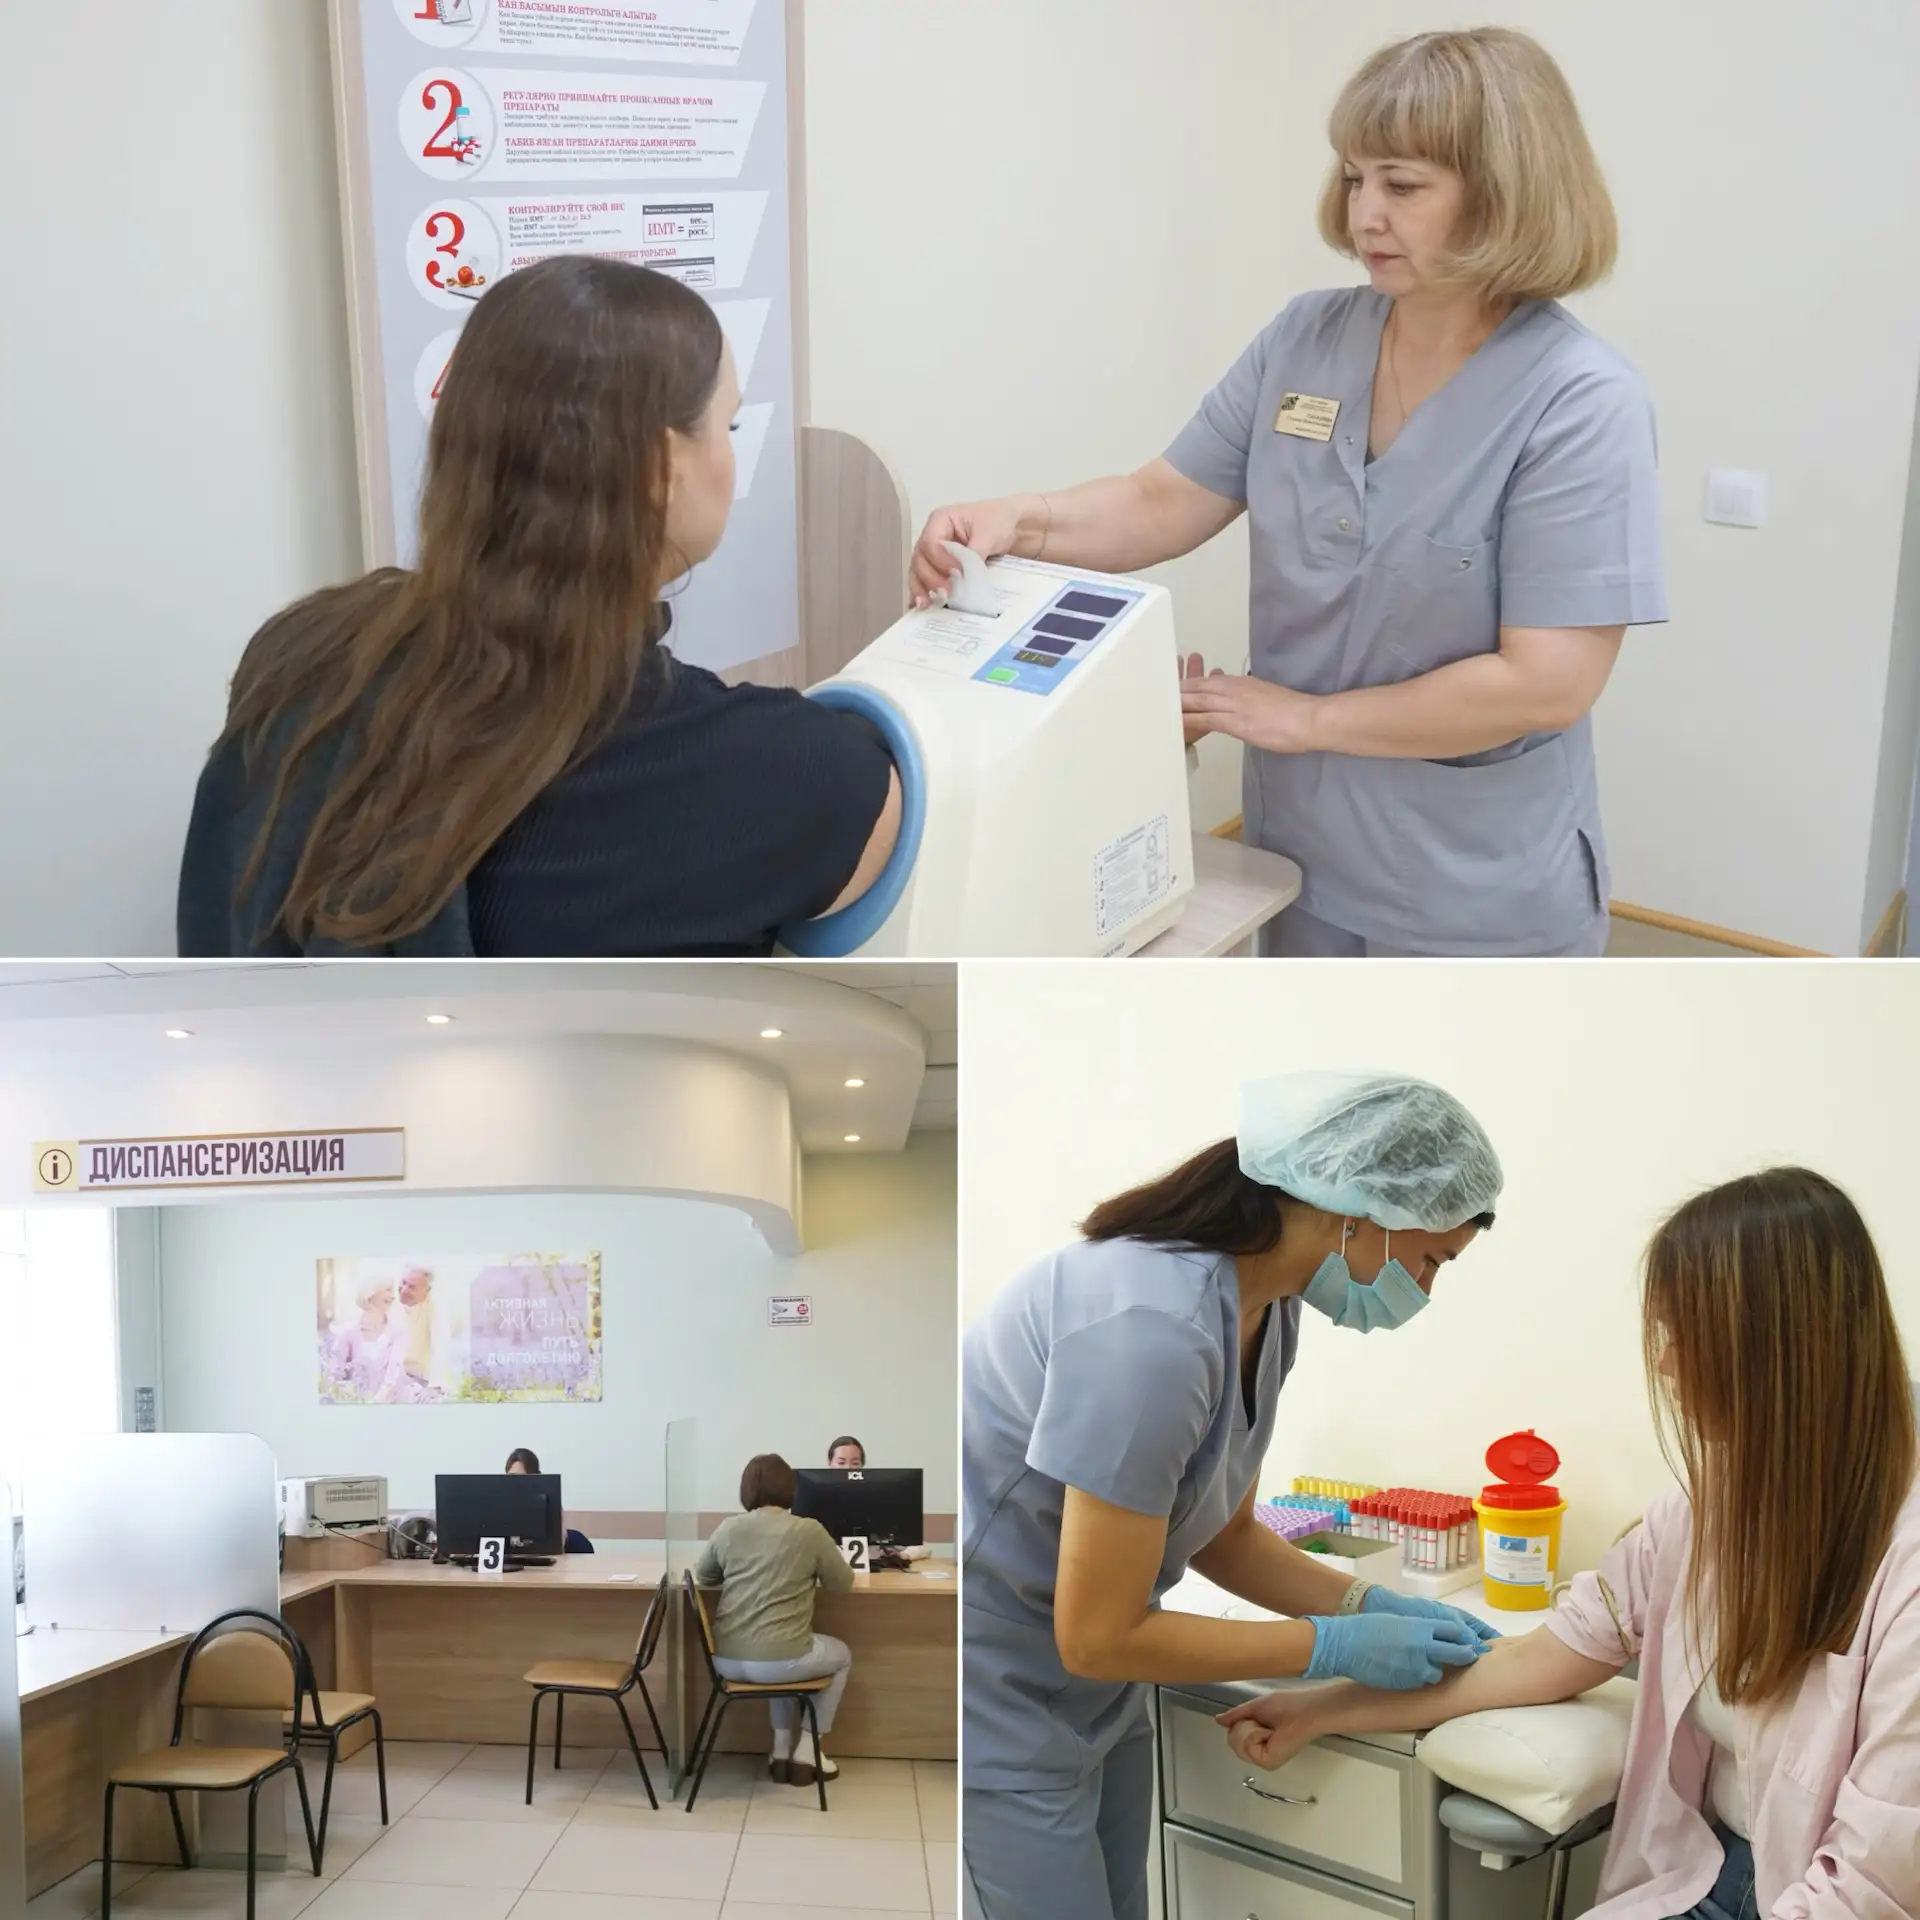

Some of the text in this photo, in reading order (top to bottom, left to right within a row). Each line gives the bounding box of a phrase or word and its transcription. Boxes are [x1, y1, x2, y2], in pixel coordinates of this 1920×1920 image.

[503, 91, 713, 106] РЕГУЛЯРНО ПРИНИМАЙТЕ ПРОПИСАННЫЕ ВРАЧОМ
[503, 102, 559, 111] ПРЕПАРАТЫ
[422, 79, 463, 157] 2
[508, 202, 625, 215] КОНТРОЛИРУЙТЕ СВОЙ ВЕС
[648, 222, 675, 236] ИМТ
[426, 211, 465, 288] 3
[89, 1138, 345, 1183] ДИСПАНСЕРИЗАЦИЯ
[484, 1298, 547, 1309] АКТИВНАЯ
[499, 1311, 579, 1330] ЖИЗНЬ
[543, 1336, 579, 1348] ПУТЬ
[486, 1352, 580, 1366] ДОЛГОЛЕТИЮ
[483, 1541, 500, 1569] 3
[848, 1540, 866, 1569] 2
